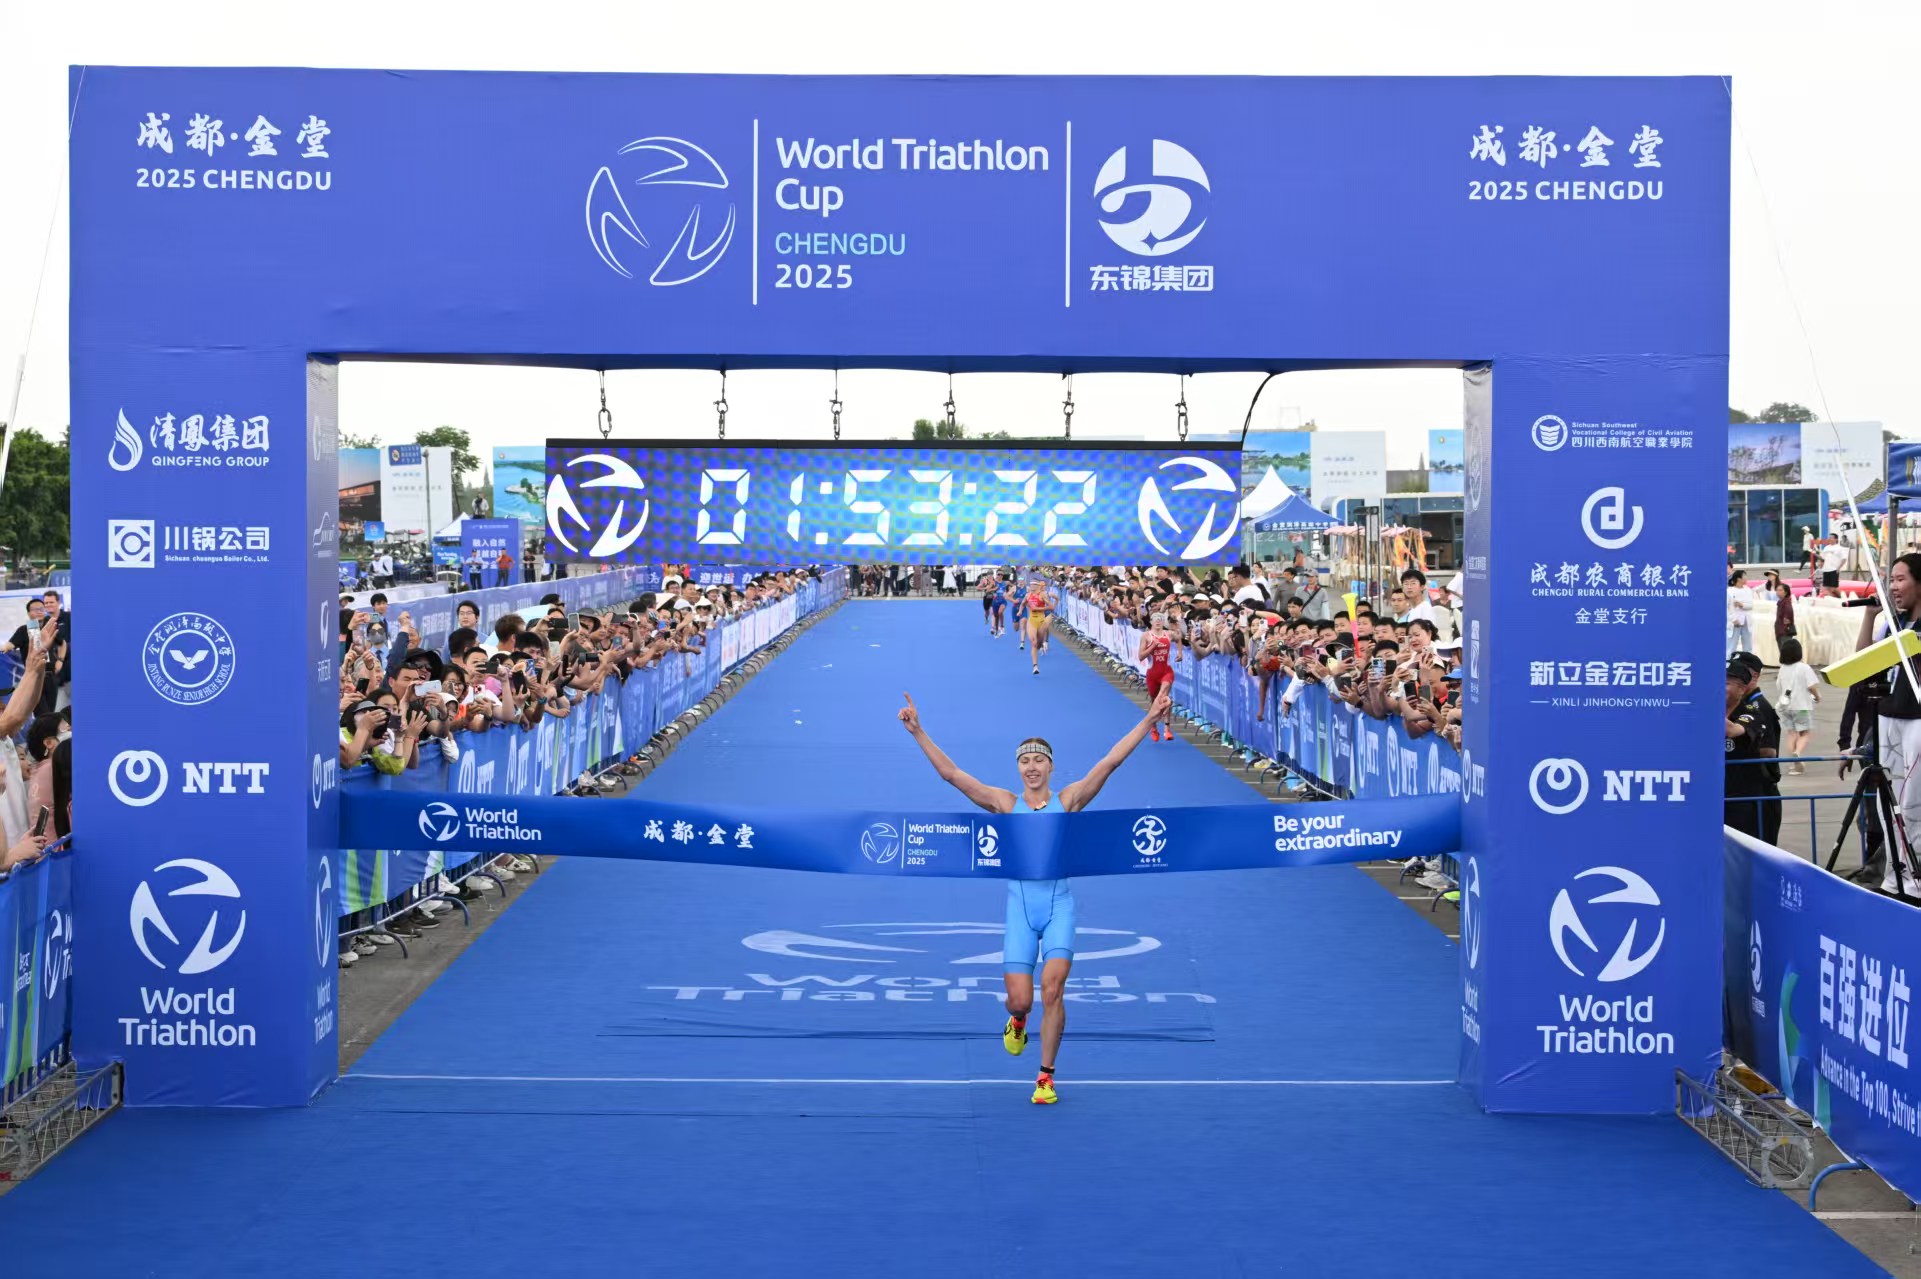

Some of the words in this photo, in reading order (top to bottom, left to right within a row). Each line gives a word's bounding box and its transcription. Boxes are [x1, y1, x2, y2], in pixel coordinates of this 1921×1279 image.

[137, 112, 332, 159] 成都·金堂
[1469, 124, 1664, 169] 成都·金堂
[775, 137, 884, 171] World
[891, 138, 1050, 172] Triathlon
[136, 168, 196, 189] 2025
[203, 168, 332, 191] CHENGDU
[1468, 181, 1529, 201] 2025
[1535, 181, 1664, 201] CHENGDU
[775, 178, 845, 218] Cup
[775, 231, 907, 256] CHENGDU
[775, 264, 854, 290] 2025
[1089, 264, 1215, 292] 东锦集团
[1610, 429, 1636, 437] College
[152, 456, 222, 467] QINGFENG
[226, 456, 270, 467] GROUP
[696, 468, 1098, 546] 01:53:22
[164, 526, 270, 551] 川锅公司
[1531, 562, 1692, 588] 成都农商银行
[1532, 588, 1574, 597] CHENGDU
[1578, 588, 1605, 597] RURAL
[1607, 588, 1664, 597] COMMERCIAL
[1667, 588, 1689, 597] BANK
[1575, 607, 1648, 625] 金堂支行
[147, 663, 163, 687] JINTANG
[162, 683, 182, 700] RUNZE
[183, 689, 205, 701] SENIOR
[215, 663, 231, 686] SCHOOL
[1530, 661, 1692, 686] 新立金宏印务
[1552, 698, 1580, 707] XINLI
[1583, 698, 1670, 707] JINHONGYINWU
[182, 763, 270, 793] NTT
[323, 758, 336, 792] NTT
[1472, 763, 1484, 798] NTT
[1603, 771, 1690, 801] NTT
[465, 807, 518, 825] World
[908, 823, 934, 834] World
[935, 824, 970, 835] Triathlon
[1273, 815, 1298, 833] Be
[1300, 815, 1345, 836] your
[465, 822, 541, 842] Triathlon
[908, 834, 924, 846] Cup
[1274, 829, 1402, 852] extraordinary
[906, 857, 926, 865] 2025
[907, 848, 938, 857] CHENGDU
[316, 977, 331, 1010] World
[745, 973, 1120, 989] Word
[140, 987, 235, 1015] World
[1464, 977, 1478, 1013] World
[1820, 934, 1911, 1069] 百强进位
[1559, 994, 1653, 1023] World
[118, 1018, 256, 1046] Triathlon
[314, 1009, 334, 1045] Triathlon
[1536, 1025, 1674, 1054] Triathlon
[1820, 1043, 1843, 1090] Advance
[1843, 1057, 1849, 1094] in
[1850, 1064, 1860, 1101] the
[1861, 1071, 1873, 1119] Top
[1875, 1079, 1891, 1128] 100,
[1892, 1088, 1915, 1135] Strive
